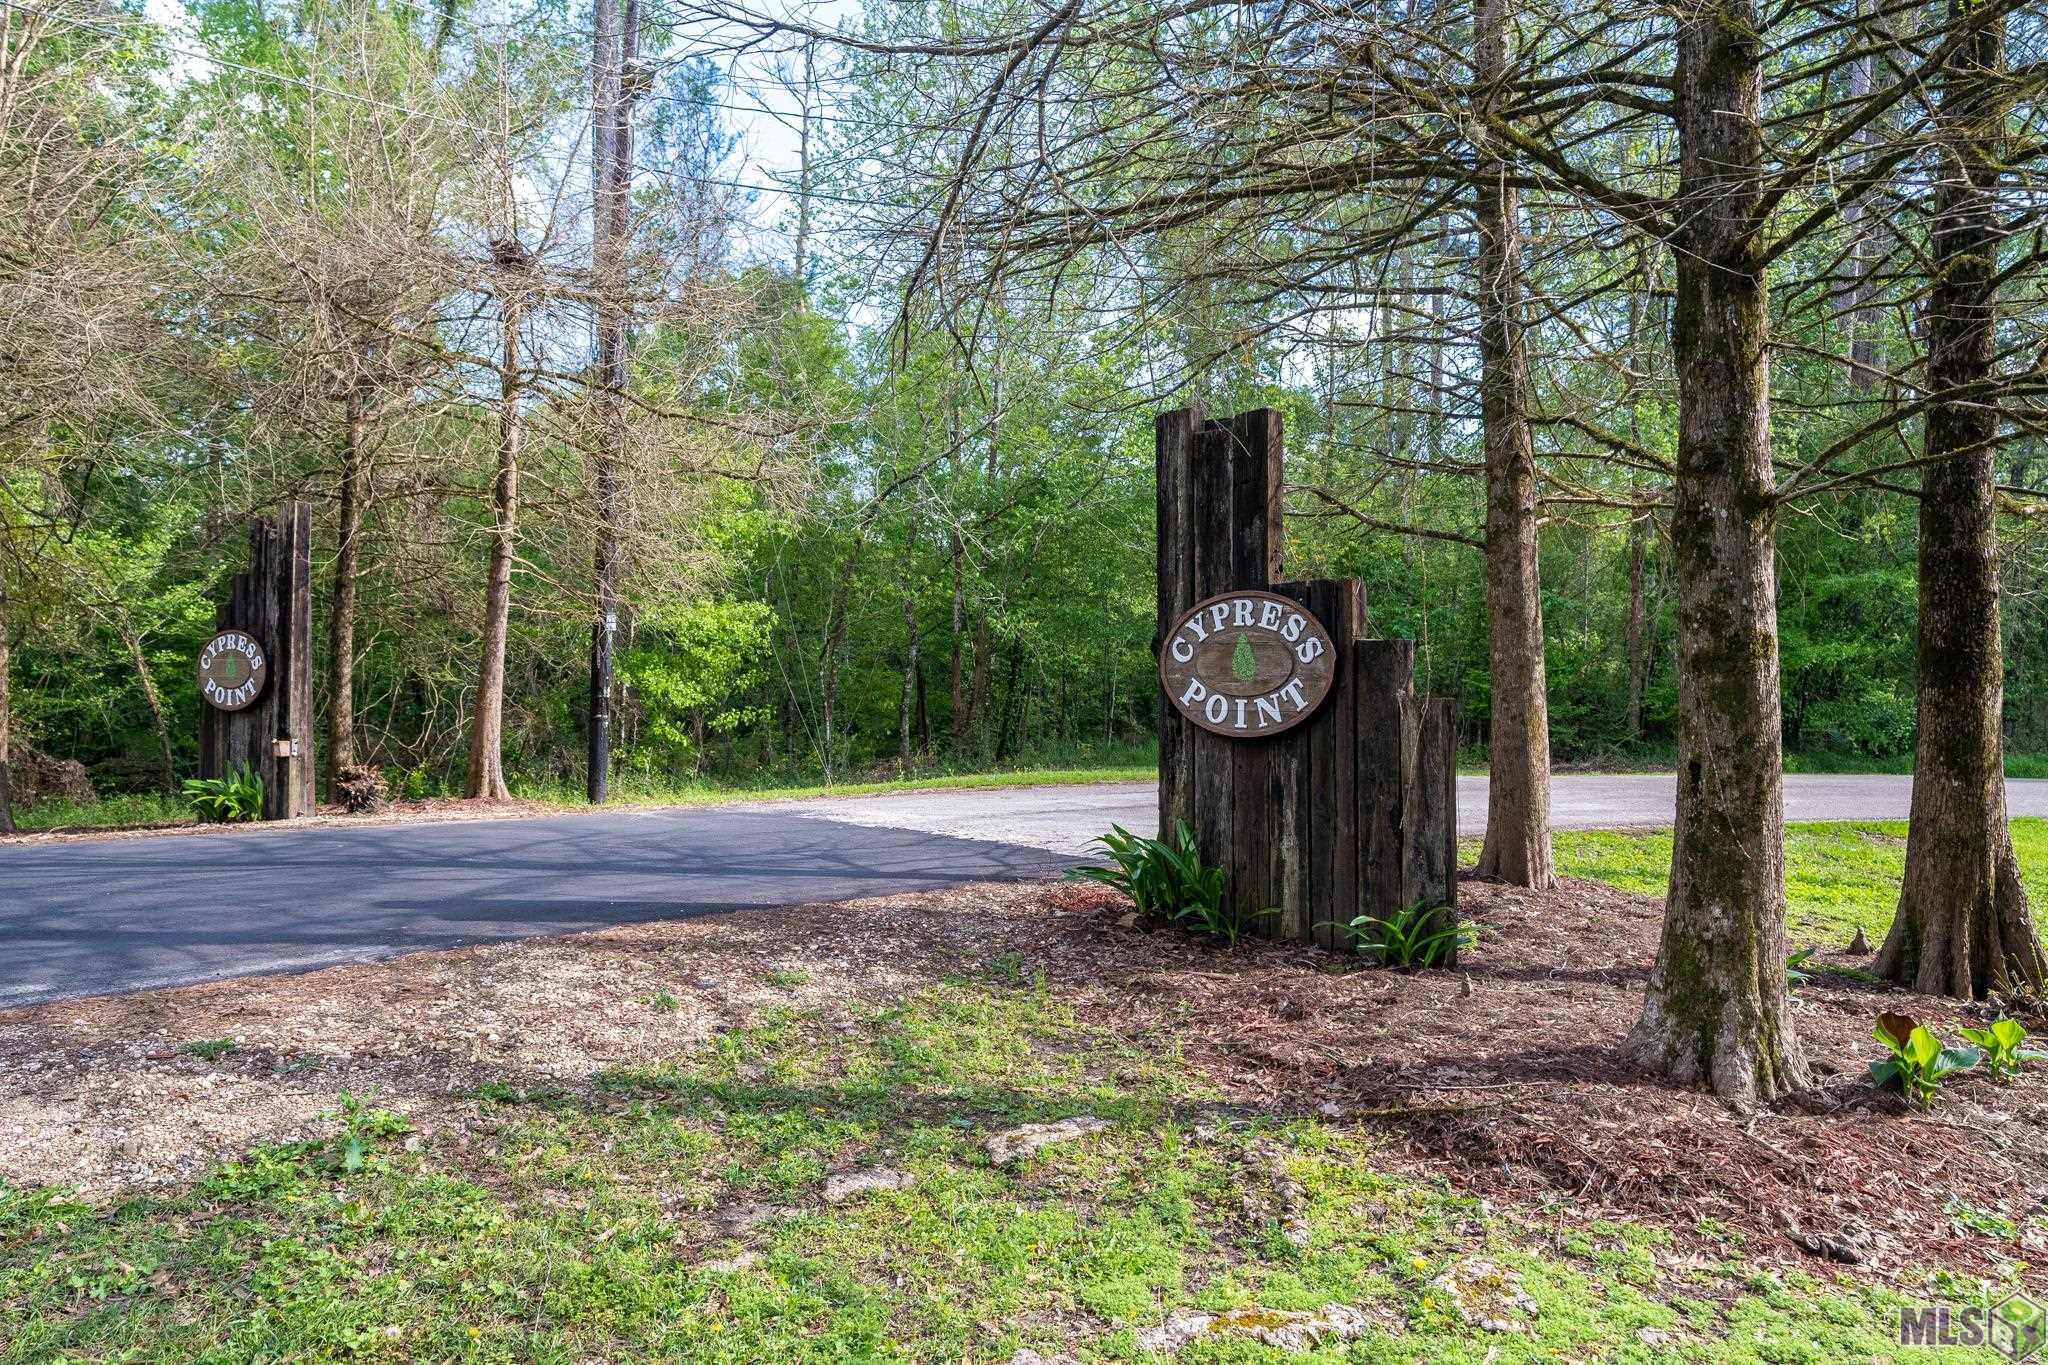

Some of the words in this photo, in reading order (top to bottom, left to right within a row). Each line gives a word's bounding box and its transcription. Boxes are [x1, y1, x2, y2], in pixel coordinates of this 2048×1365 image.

[201, 634, 262, 669] CYPRESS
[1172, 600, 1325, 664] CYPRESS
[204, 677, 256, 705] POINT
[1179, 677, 1309, 728] POINT
